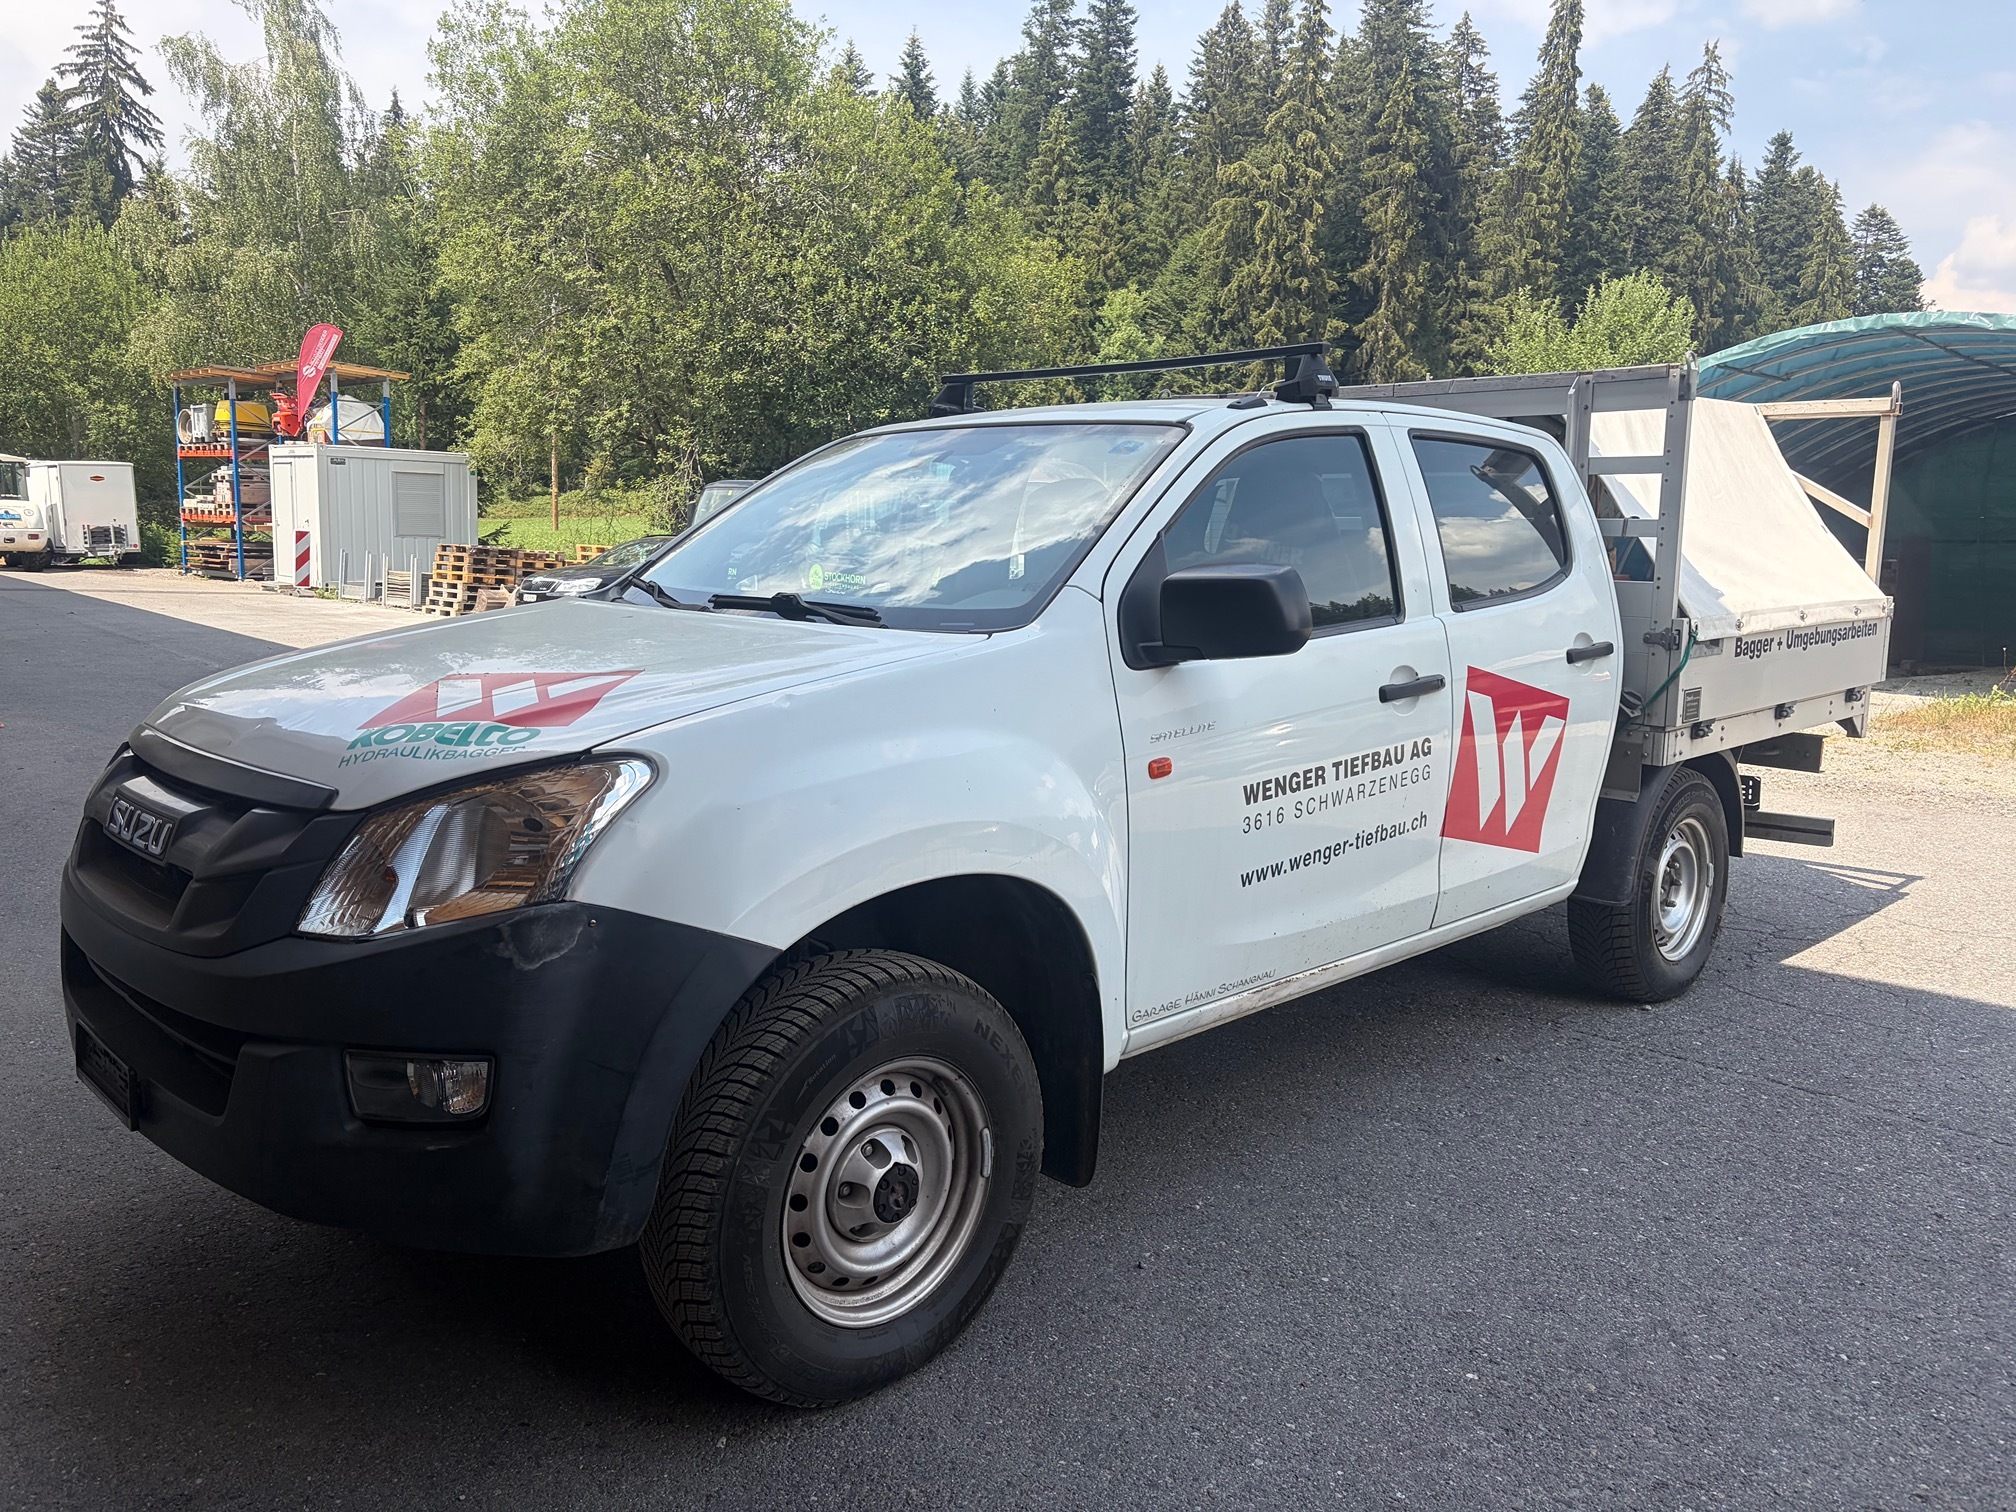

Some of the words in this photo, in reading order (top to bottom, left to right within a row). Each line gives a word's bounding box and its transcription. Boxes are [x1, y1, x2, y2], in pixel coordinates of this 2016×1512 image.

[824, 571, 866, 584] STOCKHORN
[1734, 636, 1774, 659] Bagger
[1777, 637, 1783, 650] +
[1786, 620, 1878, 650] Umgebungsarbeiten
[346, 722, 541, 750] KOBELCO
[1149, 720, 1217, 744] SATELLITE
[1242, 765, 1326, 806] WENGER
[1331, 744, 1405, 781] TIEFBAU
[1409, 737, 1432, 761] AG
[1242, 806, 1285, 834] 3616
[1294, 764, 1431, 819] SCHWARZENEGG
[1240, 811, 1428, 888] www.wenger-tiefbau.ch
[973, 1018, 1024, 1085] NEXE
